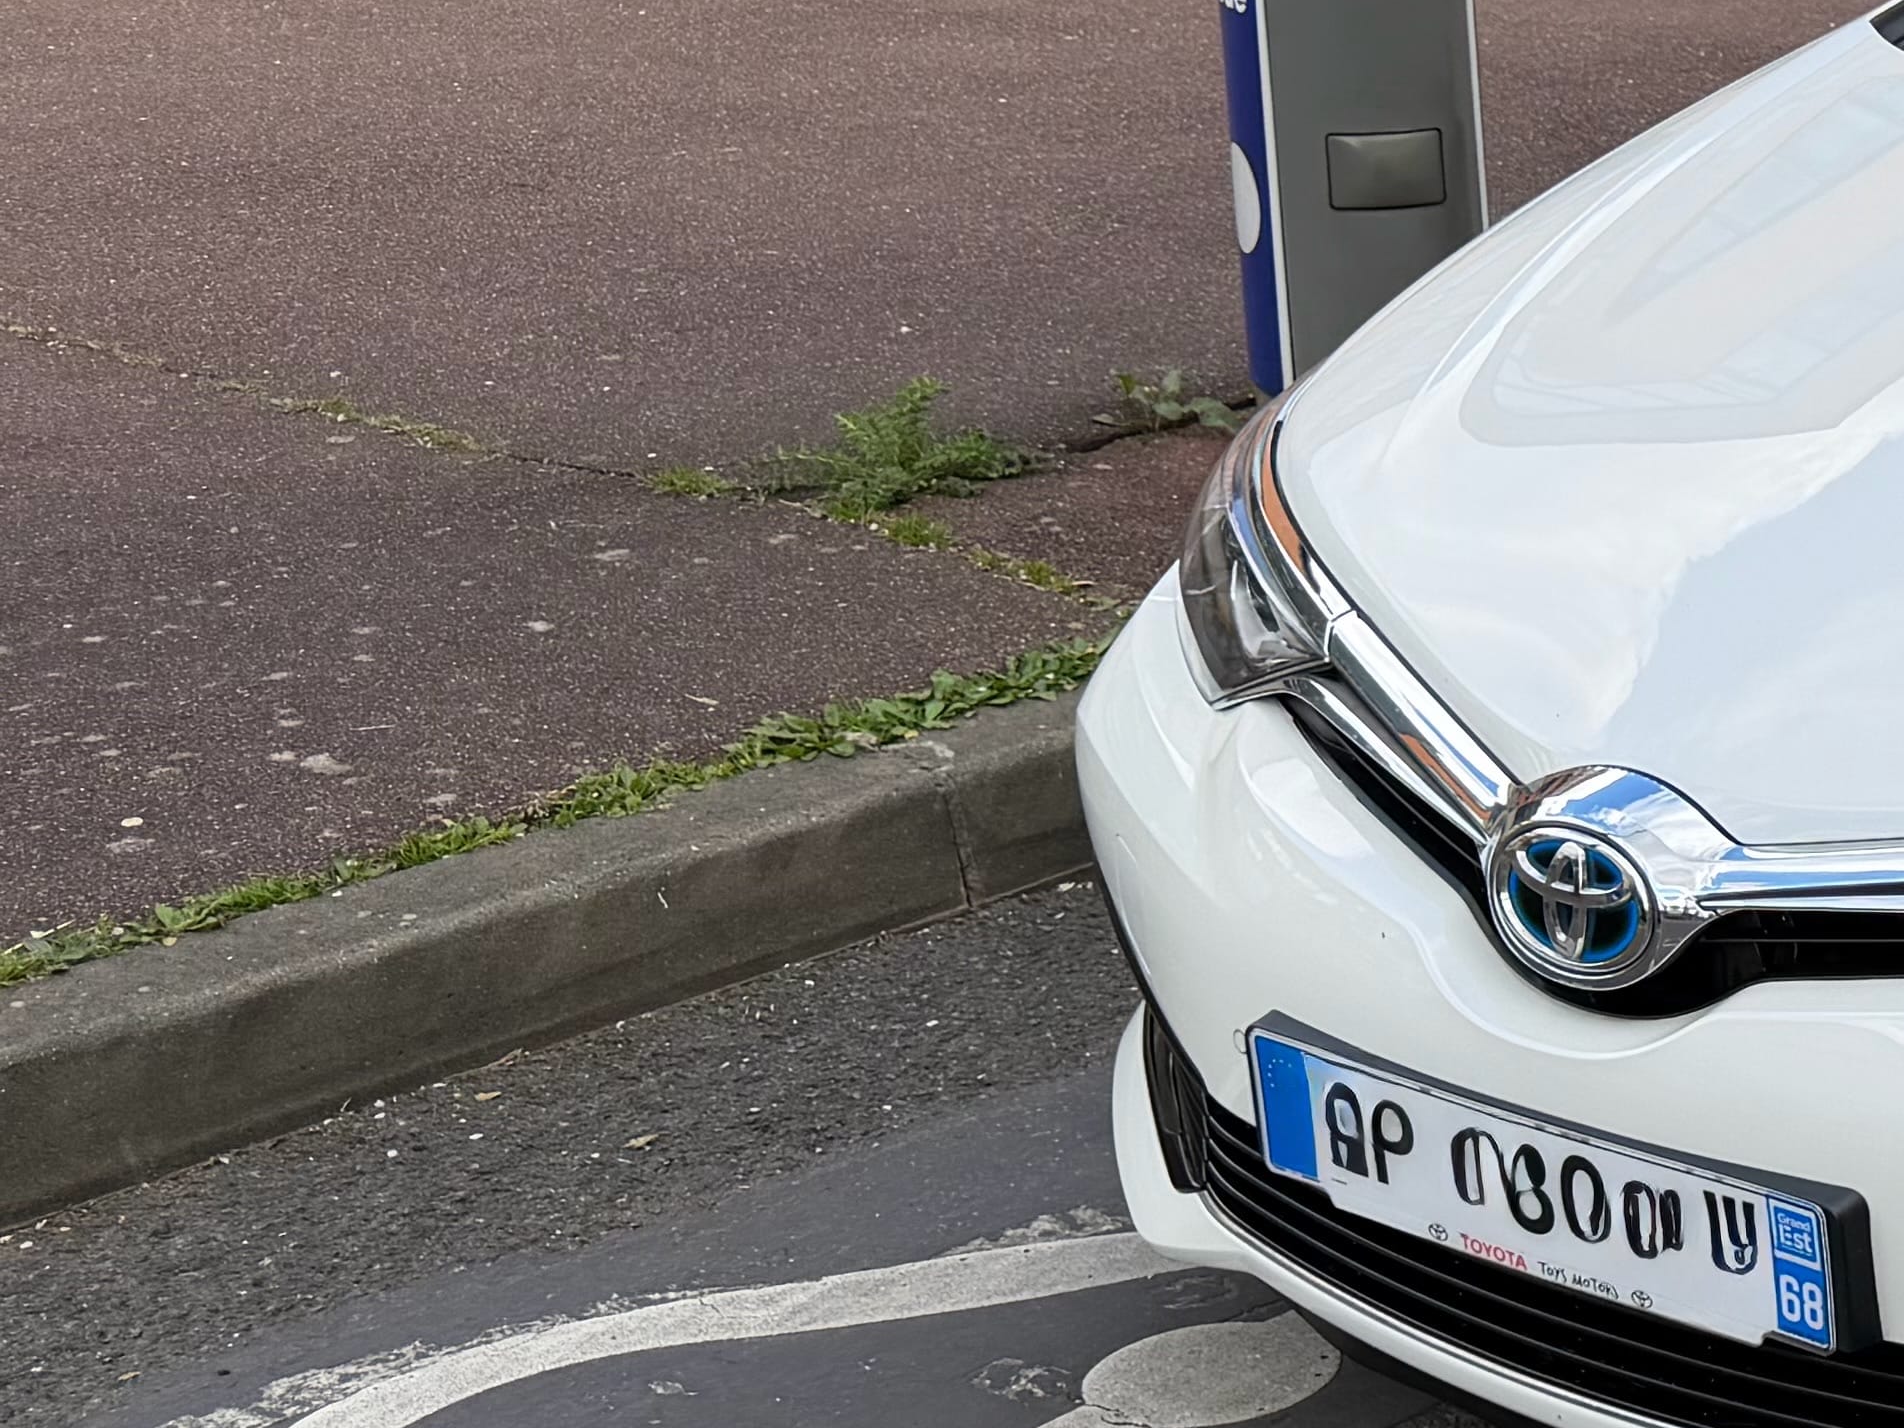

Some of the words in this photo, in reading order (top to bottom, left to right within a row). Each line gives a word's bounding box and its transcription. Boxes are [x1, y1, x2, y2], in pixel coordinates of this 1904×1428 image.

[1459, 1232, 1528, 1271] TOYOTA
[1779, 1223, 1813, 1254] Est
[1778, 1274, 1824, 1331] 68
